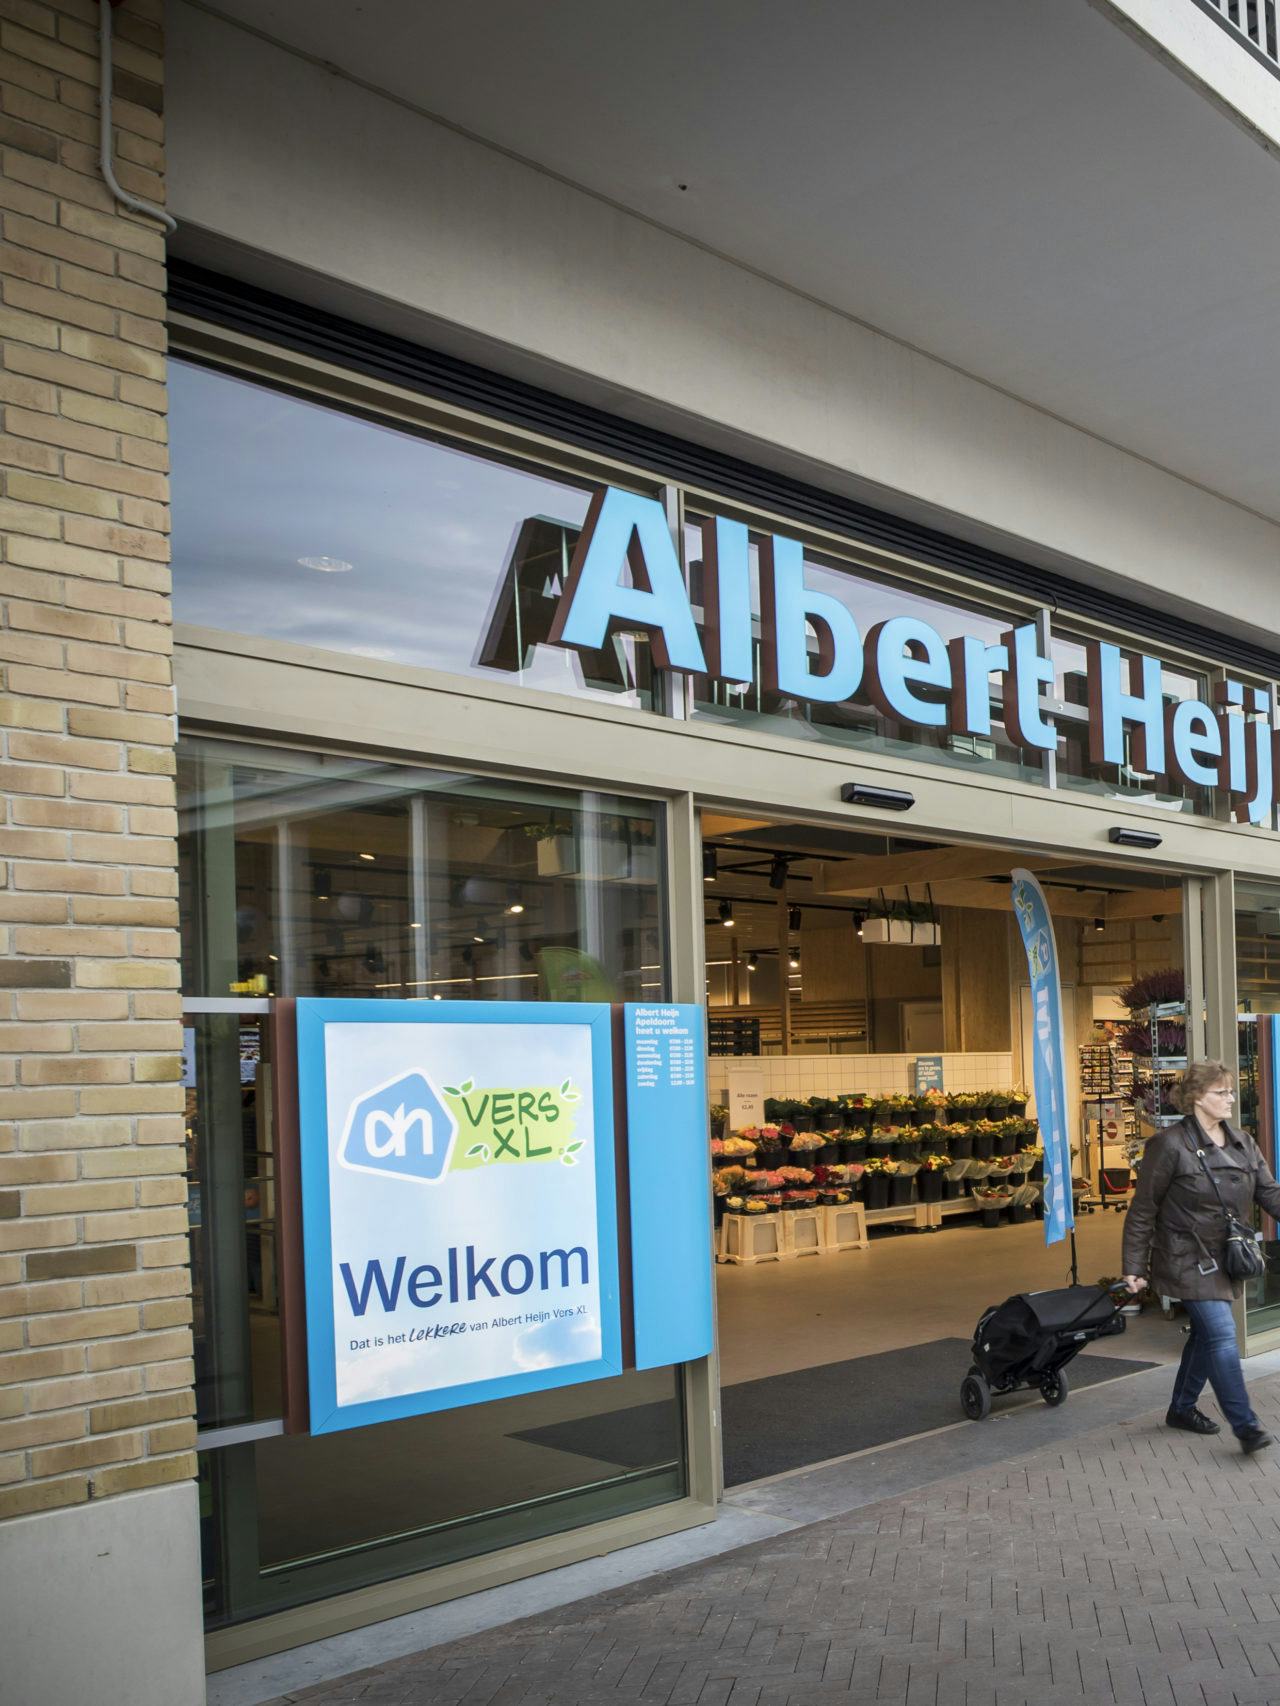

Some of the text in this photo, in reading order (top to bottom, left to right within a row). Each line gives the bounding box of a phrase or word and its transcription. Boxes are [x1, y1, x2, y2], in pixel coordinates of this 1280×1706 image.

[549, 485, 1057, 751] Albert
[635, 1008, 659, 1016] Albert
[635, 1018, 676, 1026] Apeldoorn
[462, 1092, 560, 1128] VERS
[493, 1126, 552, 1159] XL
[339, 1245, 589, 1317] Welkom
[350, 1338, 370, 1351] Dat
[374, 1336, 384, 1347] is
[387, 1333, 407, 1345] het
[469, 1321, 488, 1332] van
[491, 1315, 522, 1329] Albert
[525, 1311, 550, 1325] Heijn
[553, 1308, 574, 1319] Vers
[576, 1304, 588, 1315] XL
